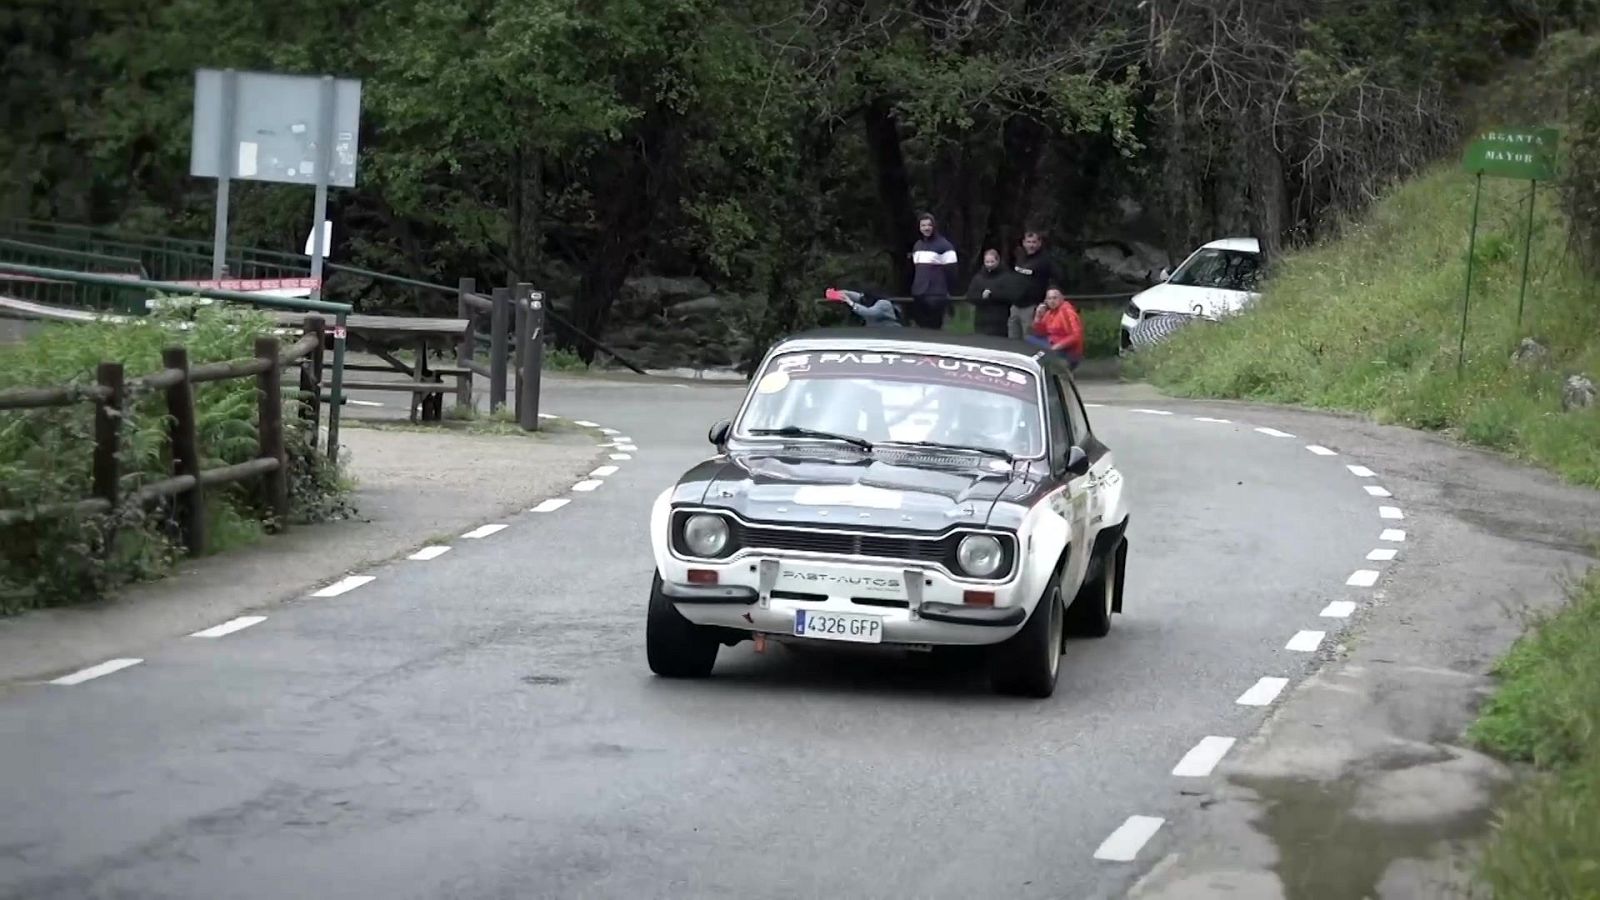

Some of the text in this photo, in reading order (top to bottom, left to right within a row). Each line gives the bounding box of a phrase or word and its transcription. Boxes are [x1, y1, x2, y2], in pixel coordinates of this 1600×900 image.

[1474, 131, 1543, 145] ARGANTA
[1484, 150, 1533, 163] MAYOR
[808, 616, 879, 636] 4326 GFP
